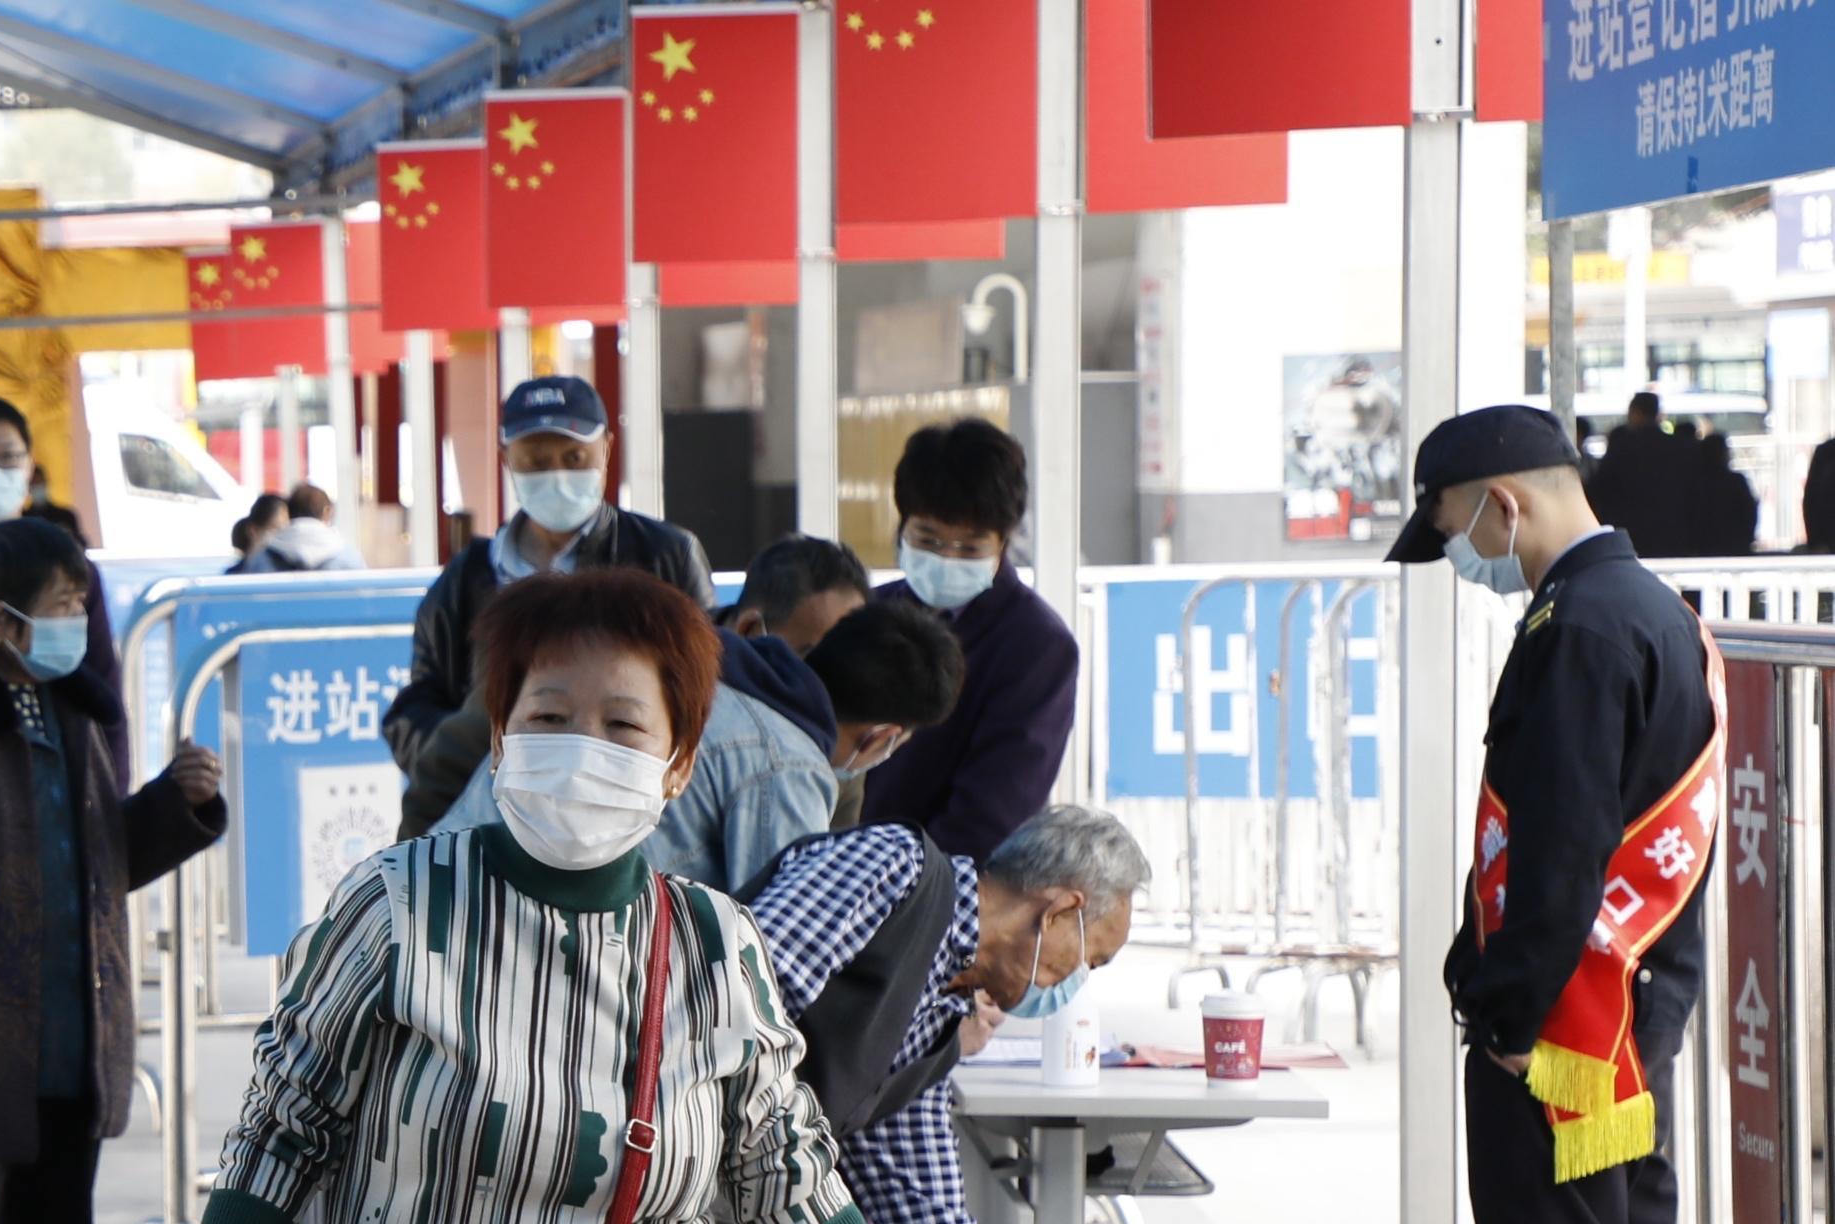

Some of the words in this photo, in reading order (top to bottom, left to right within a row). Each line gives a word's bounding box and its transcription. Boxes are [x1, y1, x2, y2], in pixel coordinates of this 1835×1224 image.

[1635, 44, 1775, 158] 请保持1米距离
[1732, 753, 1770, 1090] 安全
[1738, 1120, 1775, 1163] Secure
